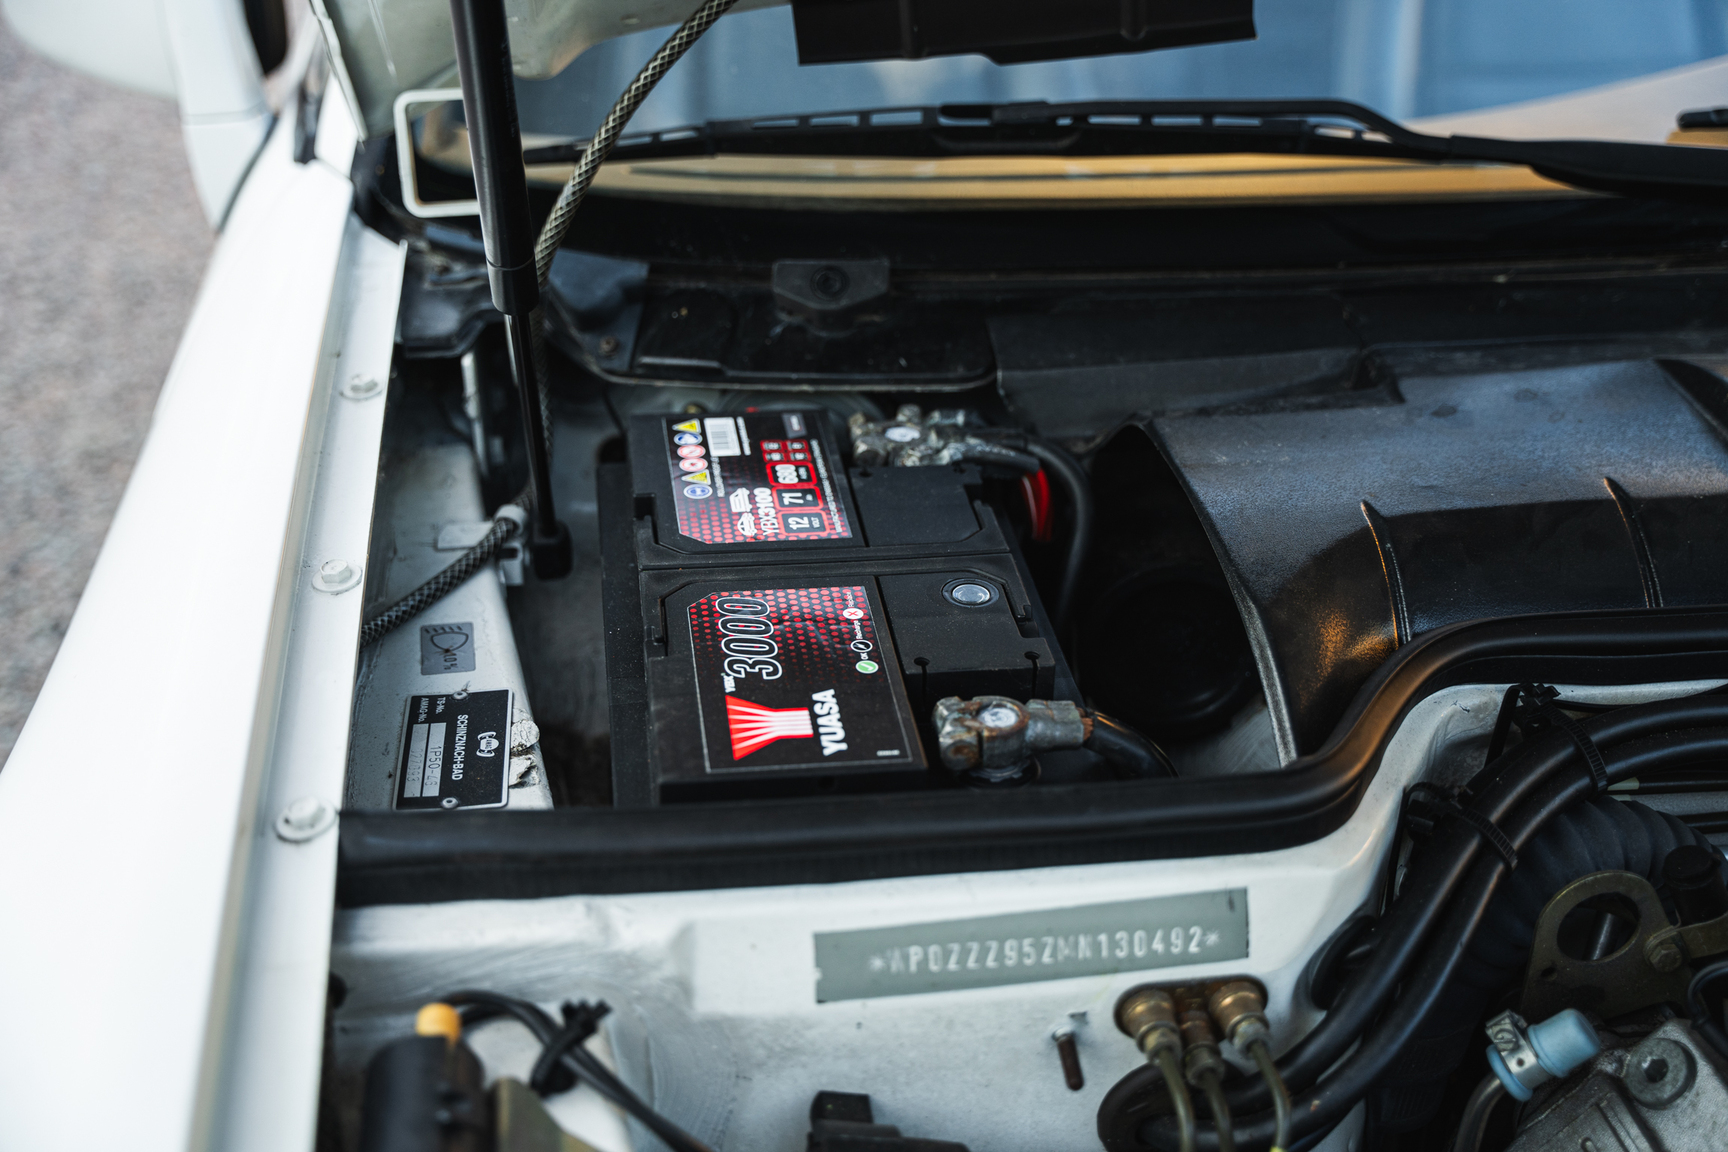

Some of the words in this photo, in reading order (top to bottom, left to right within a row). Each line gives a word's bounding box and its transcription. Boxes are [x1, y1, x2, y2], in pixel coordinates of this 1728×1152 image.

[781, 492, 804, 505] 71
[753, 487, 780, 536] YBX3100
[788, 516, 810, 530] 12
[811, 517, 821, 529] VOLT
[715, 596, 782, 680] 3000
[855, 620, 863, 640] Recharge
[860, 652, 869, 660] OK
[812, 689, 848, 756] YUASA
[452, 714, 469, 780] SCHINZNACH-BAD
